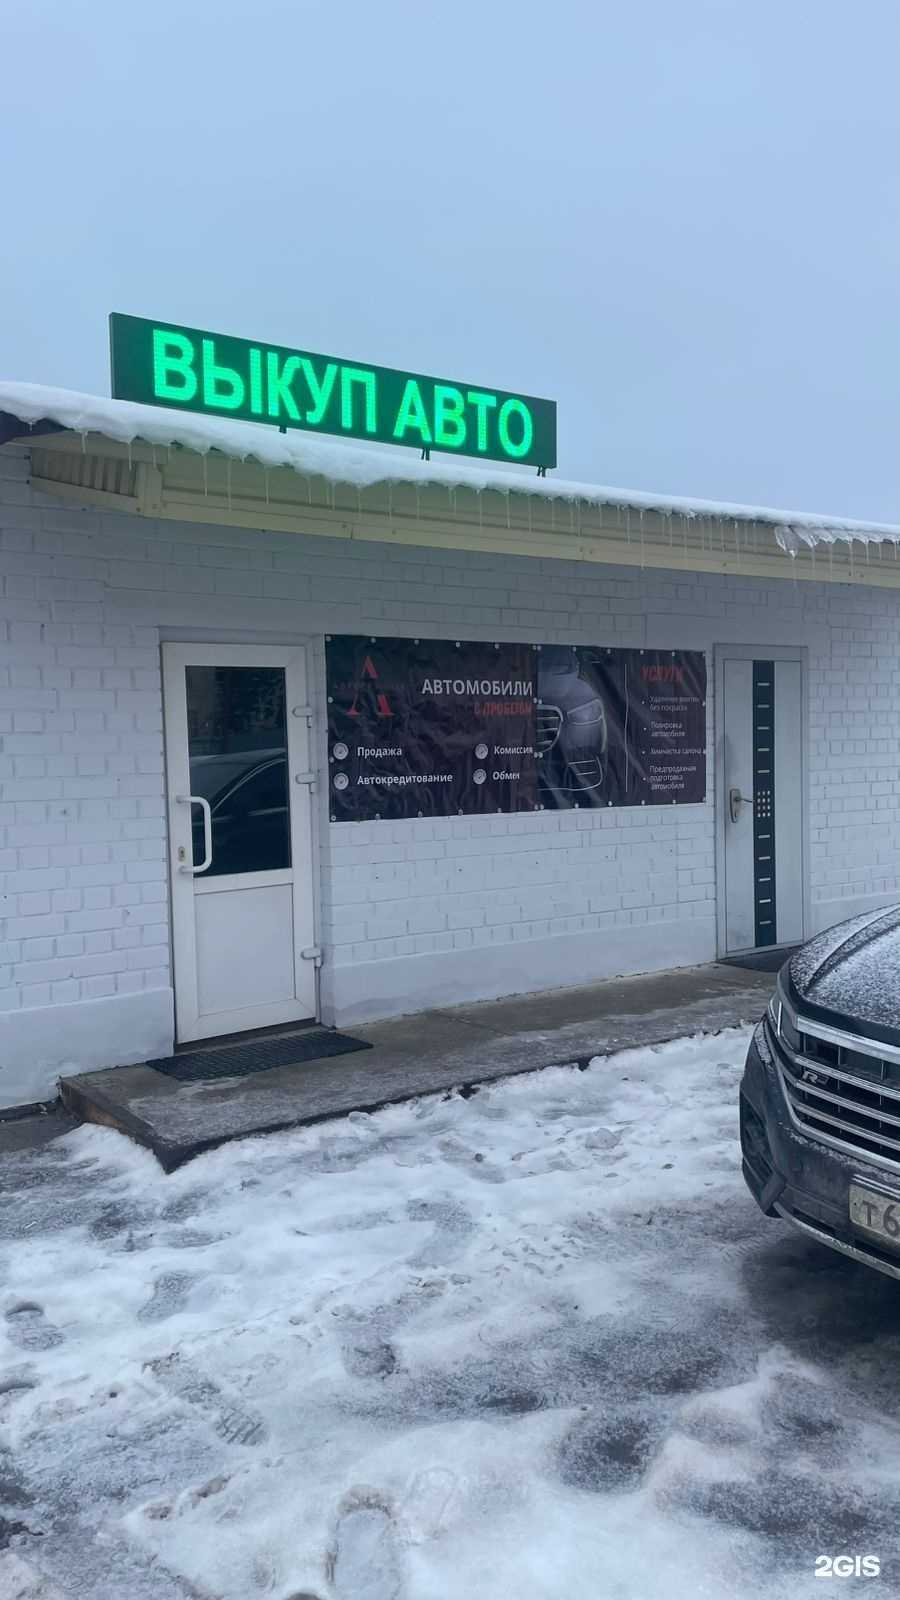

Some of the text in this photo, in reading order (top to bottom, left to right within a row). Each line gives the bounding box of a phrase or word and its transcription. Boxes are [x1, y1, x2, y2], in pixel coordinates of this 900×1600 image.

[153, 329, 534, 457] ВЫКУП АВТО
[421, 679, 533, 696] АВТОМОБИЛИ
[357, 746, 402, 759] Продажа
[494, 745, 534, 755] Комиссия
[357, 774, 453, 786] Автокредитование
